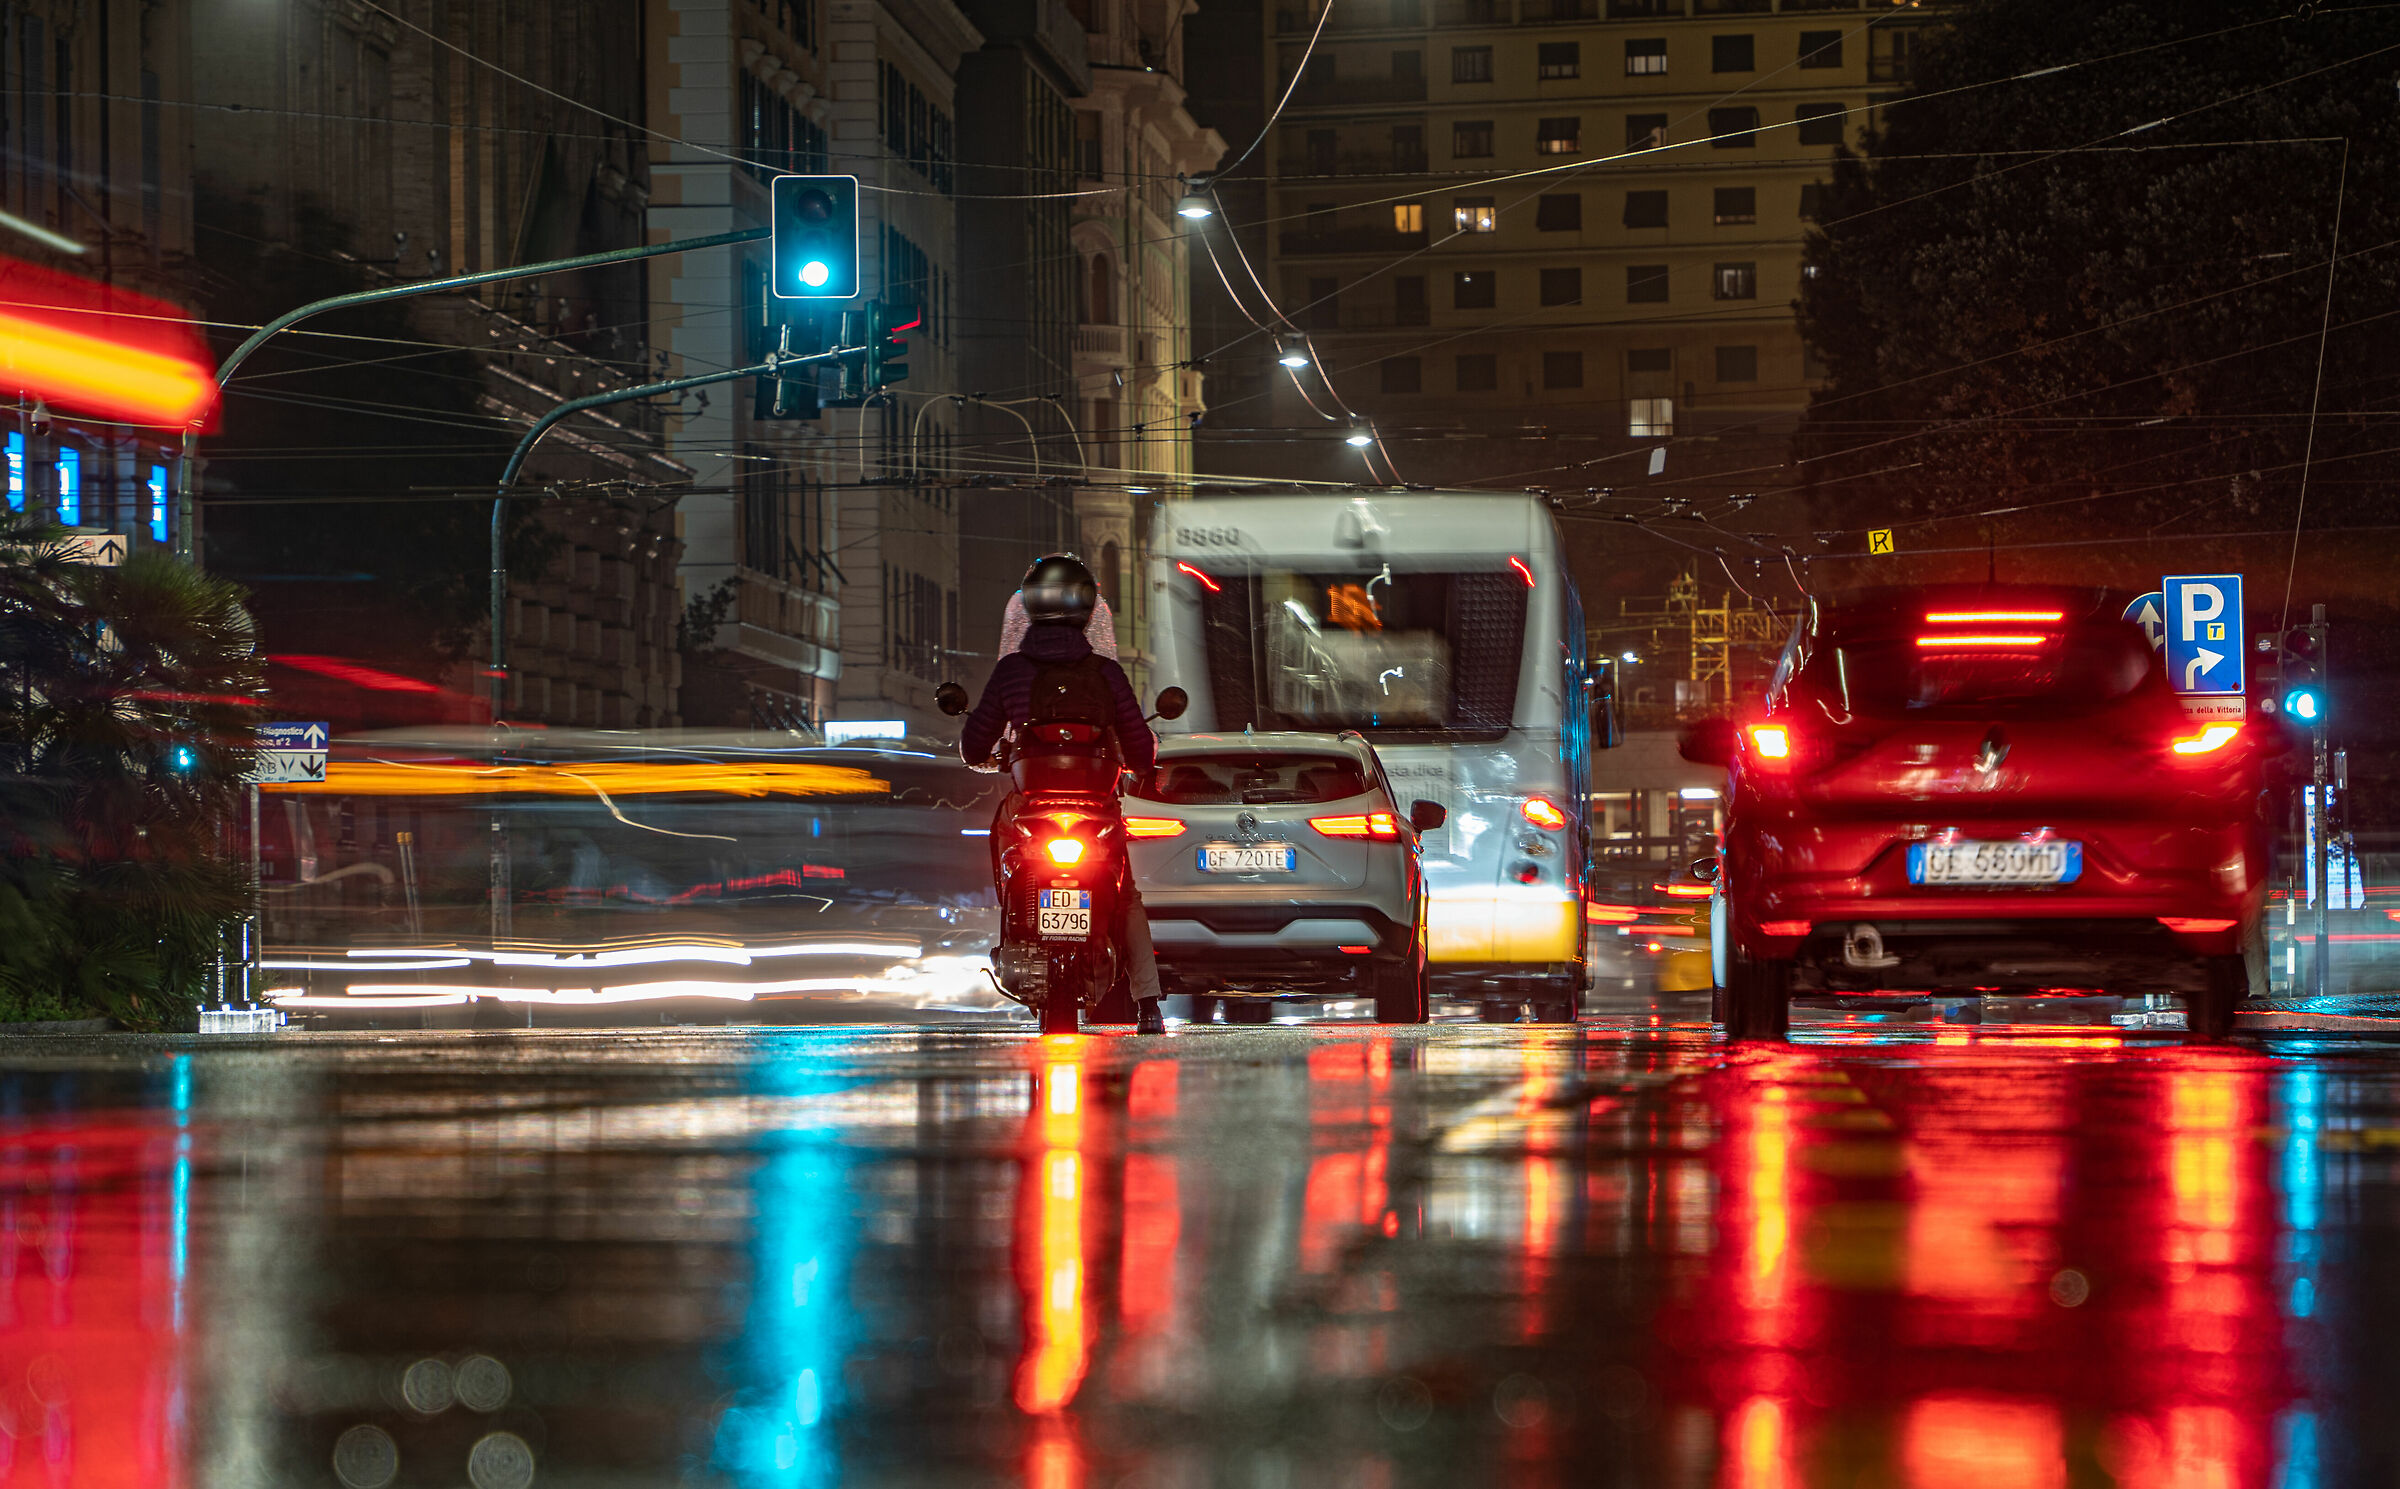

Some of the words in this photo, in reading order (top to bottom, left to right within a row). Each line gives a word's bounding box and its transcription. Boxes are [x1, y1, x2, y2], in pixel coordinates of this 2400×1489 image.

[1176, 526, 1239, 546] 8860
[2181, 583, 2225, 642] P
[2210, 625, 2222, 638] T
[2197, 706, 2213, 714] della
[2217, 706, 2241, 714] Vittoria
[1208, 850, 1228, 867] GF
[1235, 850, 1284, 867] 720TE
[1052, 891, 1071, 907] ED
[1041, 913, 1088, 930] 63796
